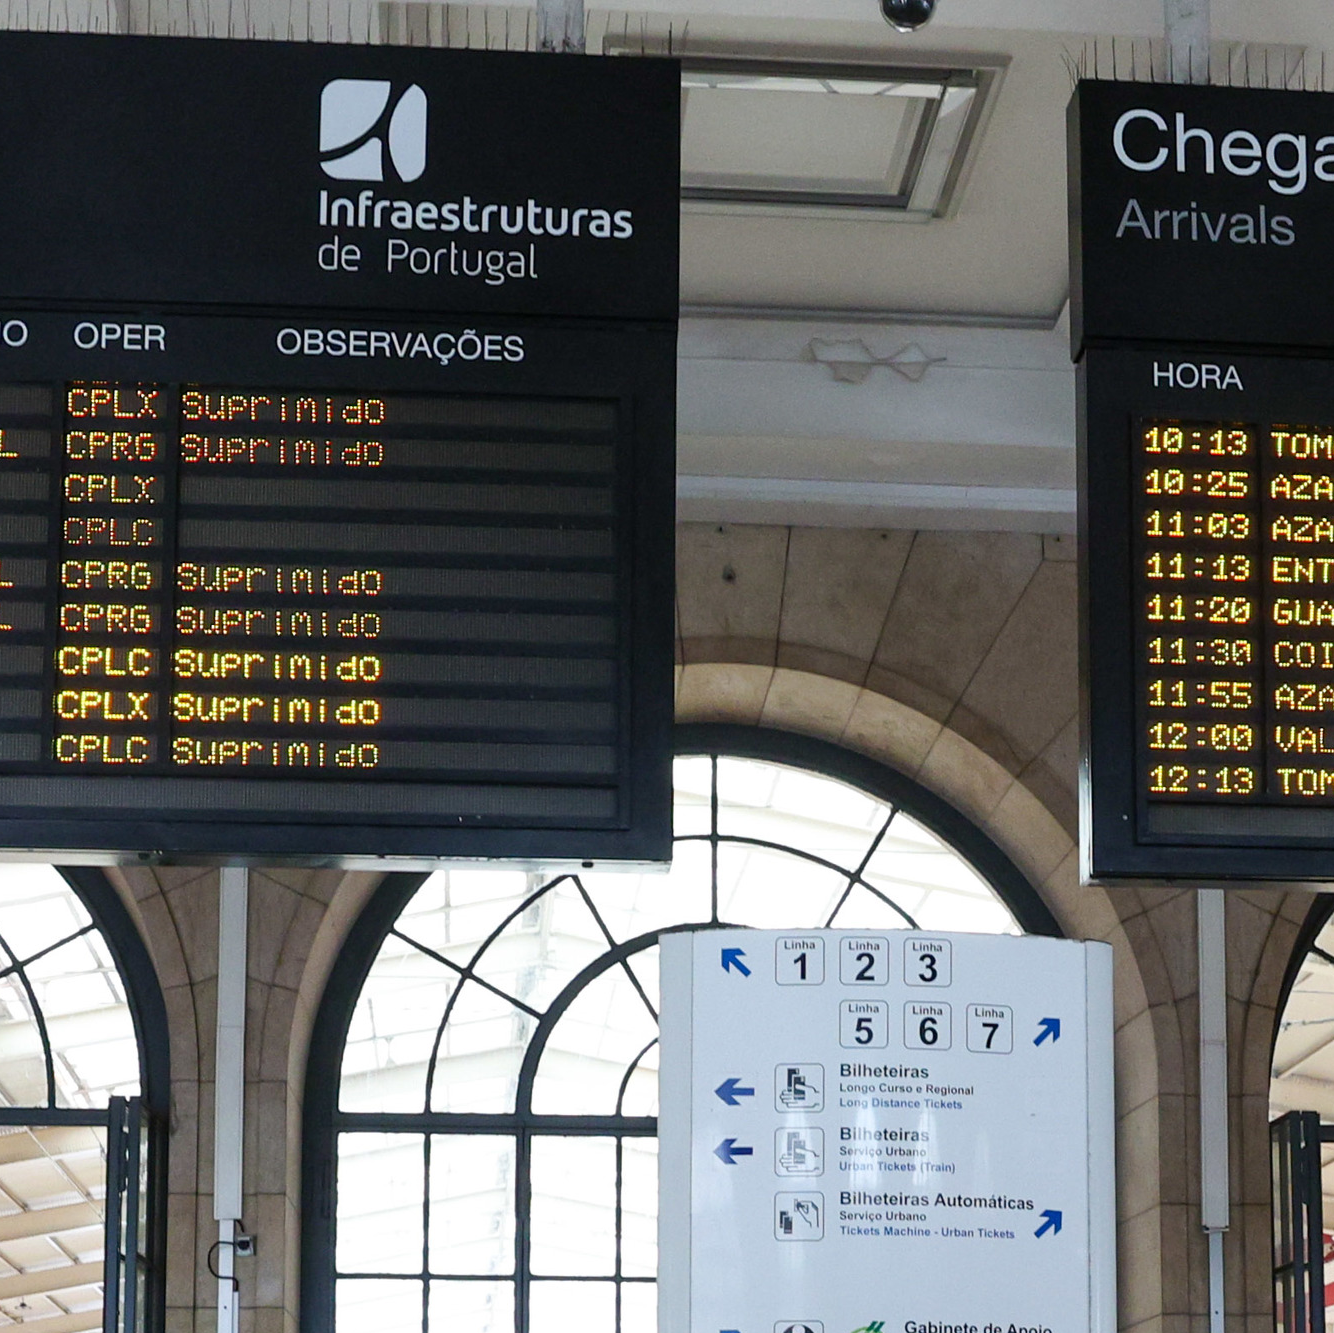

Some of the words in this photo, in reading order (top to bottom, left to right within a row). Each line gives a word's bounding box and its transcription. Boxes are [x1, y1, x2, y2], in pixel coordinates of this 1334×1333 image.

[320, 190, 632, 238] Infraestruturas
[1116, 199, 1295, 245] Arrivals
[318, 235, 360, 271] de
[388, 239, 537, 285] Portugal
[74, 322, 165, 350] OPER
[277, 328, 524, 365] OBSERVAÇÕES
[1154, 362, 1243, 390] HORA
[68, 389, 158, 418] CPLX
[67, 432, 157, 461] CPRG
[1145, 427, 1247, 455] 10:13
[65, 475, 155, 503] CPLX
[1146, 470, 1248, 498] 10:25
[64, 518, 152, 545] CPLC
[1147, 512, 1249, 539] 11:03
[62, 561, 151, 590] CPRG
[1147, 553, 1250, 581] 11:13
[61, 604, 153, 634] CPRG
[1148, 596, 1250, 624] 11:20
[55, 647, 152, 676] CPLC
[1149, 638, 1251, 664] 11:30
[55, 690, 151, 721] CPLX
[1150, 681, 1252, 708] 11:55
[57, 735, 149, 764] CPLC
[1150, 723, 1252, 751] 12:00
[1150, 766, 1253, 794] 12:13
[784, 941, 815, 950] Linha
[849, 941, 880, 951] Linha
[913, 942, 942, 952] Linha
[794, 952, 806, 980] 1
[855, 952, 875, 981] 2
[919, 953, 937, 982] 3
[849, 1004, 879, 1013] Linha
[913, 1005, 942, 1015] Linha
[975, 1008, 1004, 1018] Linha
[855, 1017, 873, 1045] 5
[919, 1017, 938, 1045] 6
[982, 1022, 999, 1049] 7
[840, 1063, 929, 1078] Bilheteiras
[839, 1098, 868, 1109] Long
[872, 1098, 920, 1108] Distance
[925, 1099, 962, 1109] Tickets
[840, 1083, 875, 1094] Longo
[879, 1083, 912, 1093] Curso
[926, 1084, 973, 1096] Regional
[840, 1127, 928, 1141] Bilheteiras
[840, 1191, 929, 1206] Bilheteiras
[934, 1193, 1034, 1210] Automáticas
[840, 1211, 882, 1222] Serviço
[886, 1211, 926, 1221] Urbano
[840, 1226, 880, 1235] Tickets
[884, 1226, 930, 1236] Machine
[942, 1227, 974, 1237] Urban
[978, 1228, 1014, 1239] Tickets
